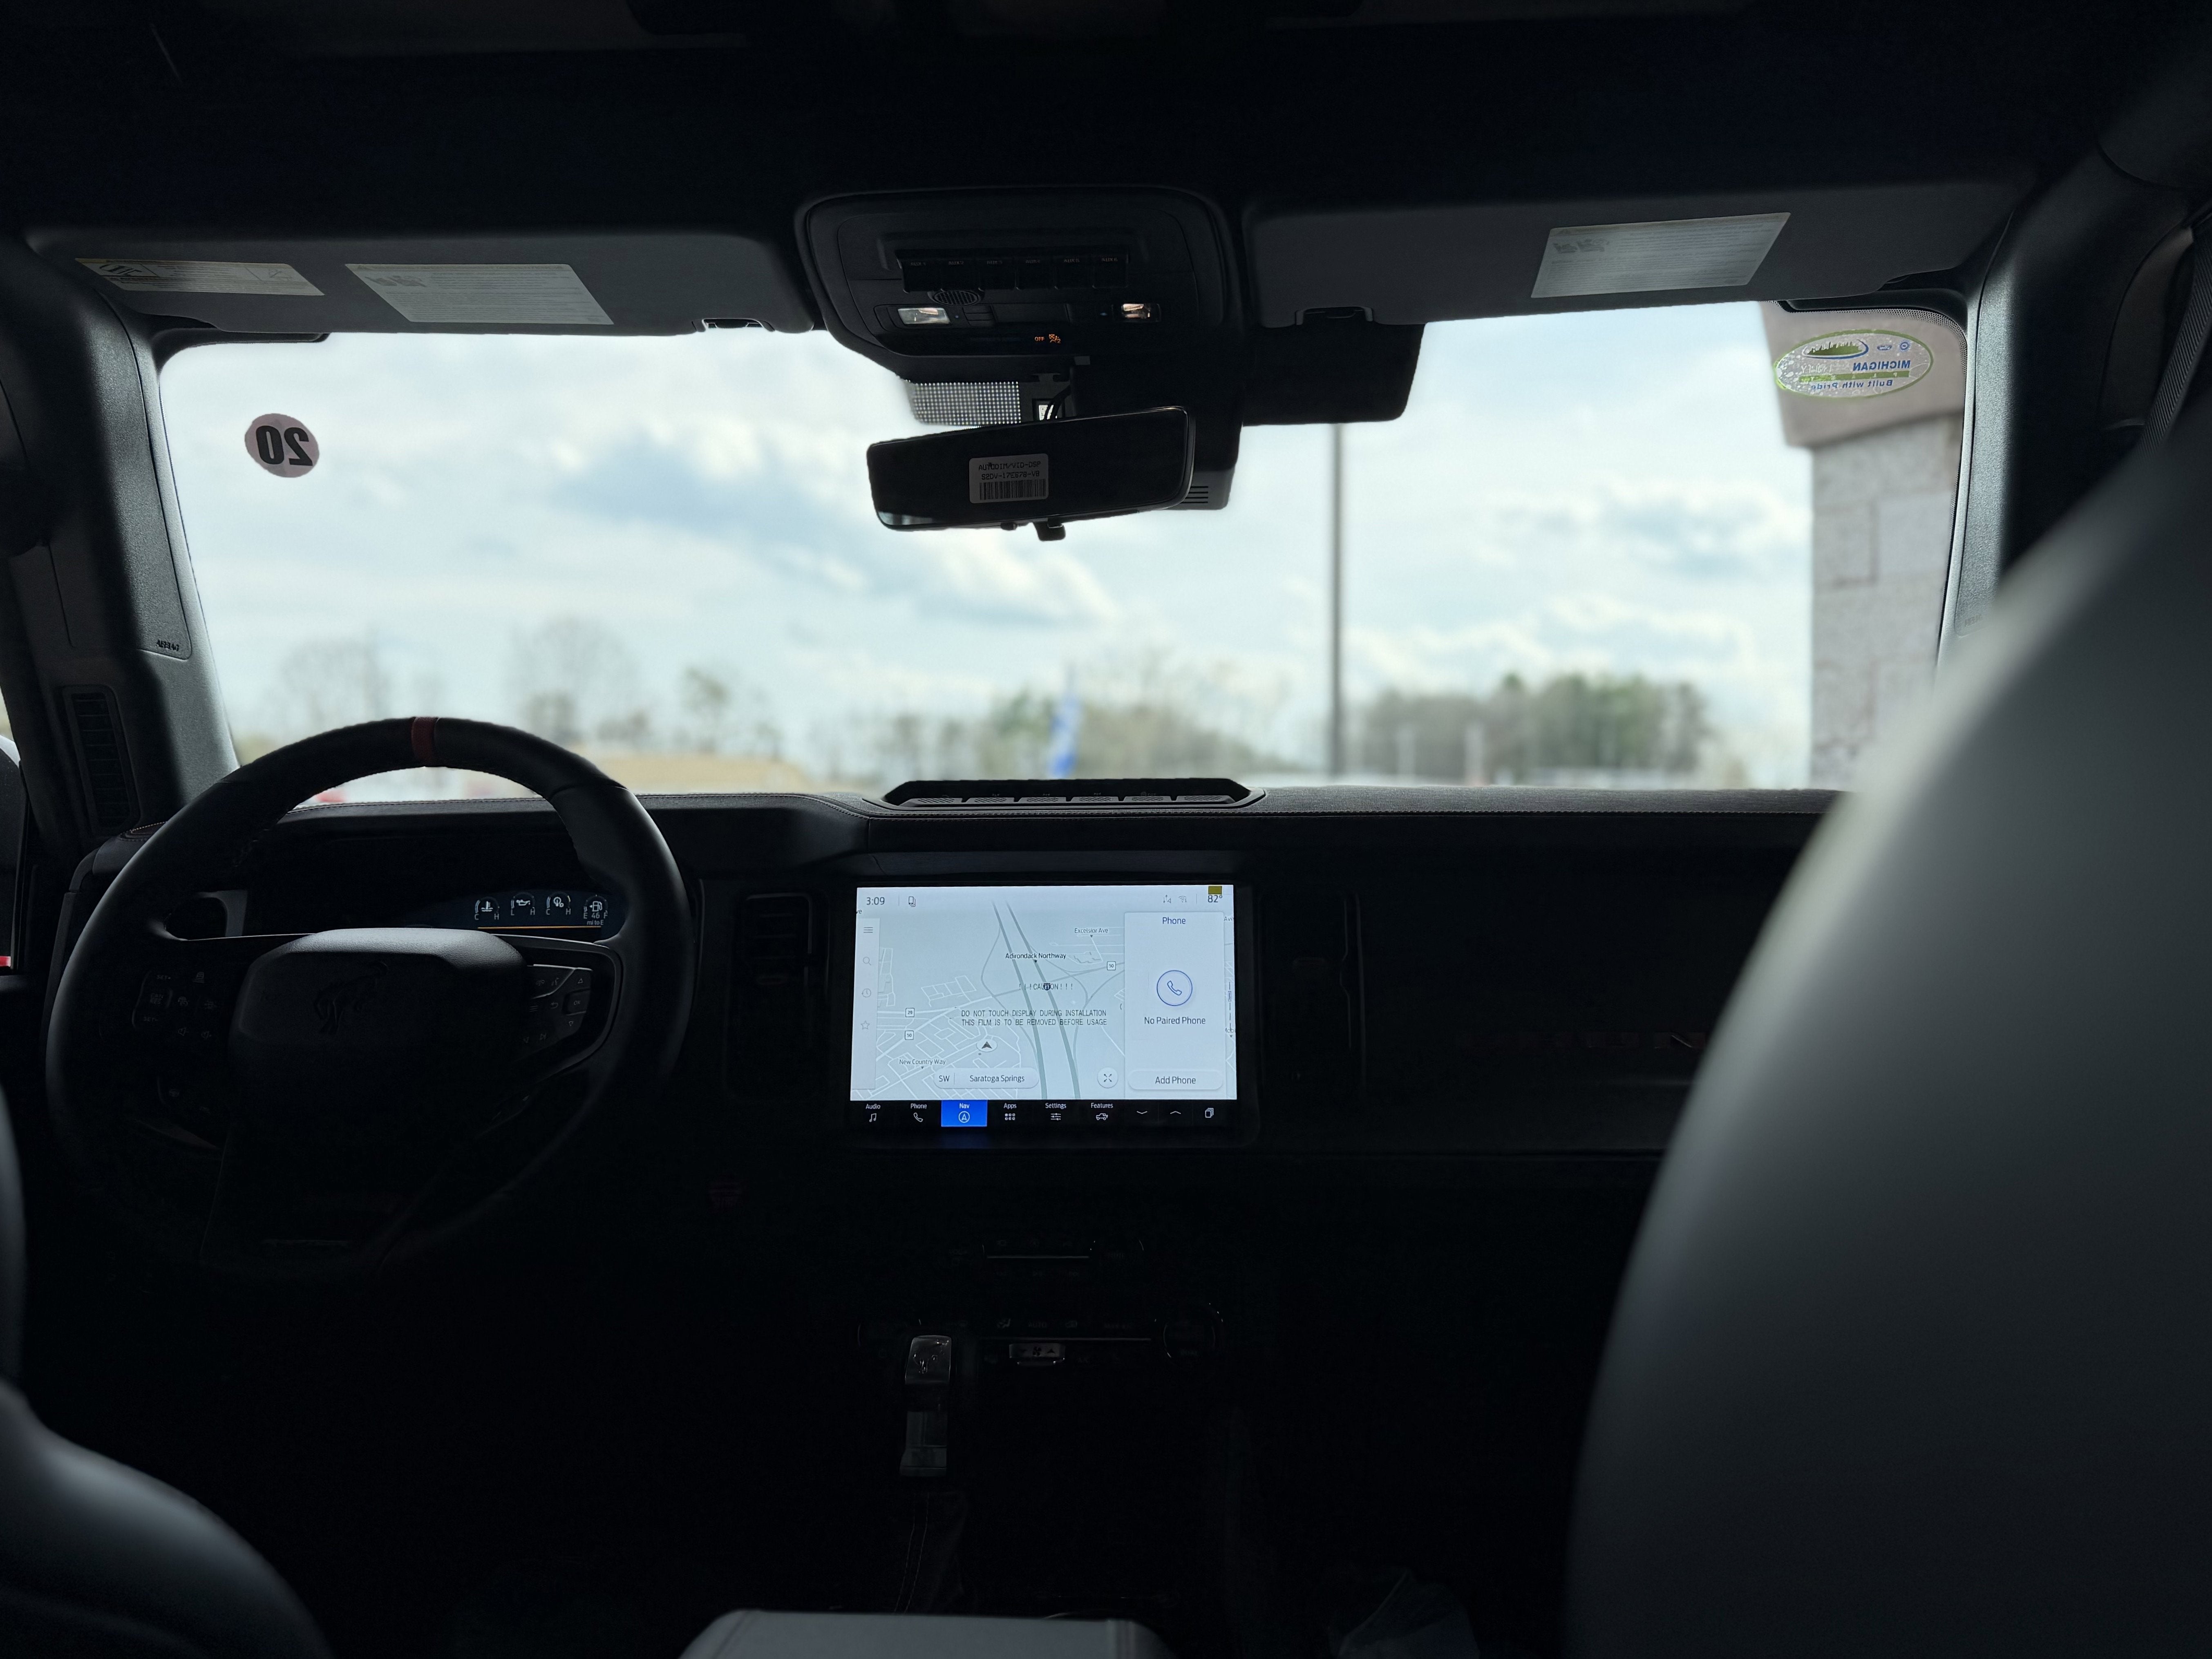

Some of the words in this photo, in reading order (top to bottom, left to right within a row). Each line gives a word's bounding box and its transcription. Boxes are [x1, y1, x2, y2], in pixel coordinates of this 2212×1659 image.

[866, 897, 885, 905] 3:09
[970, 1075, 999, 1083] Saratoga
[1001, 1075, 1024, 1083] Springs
